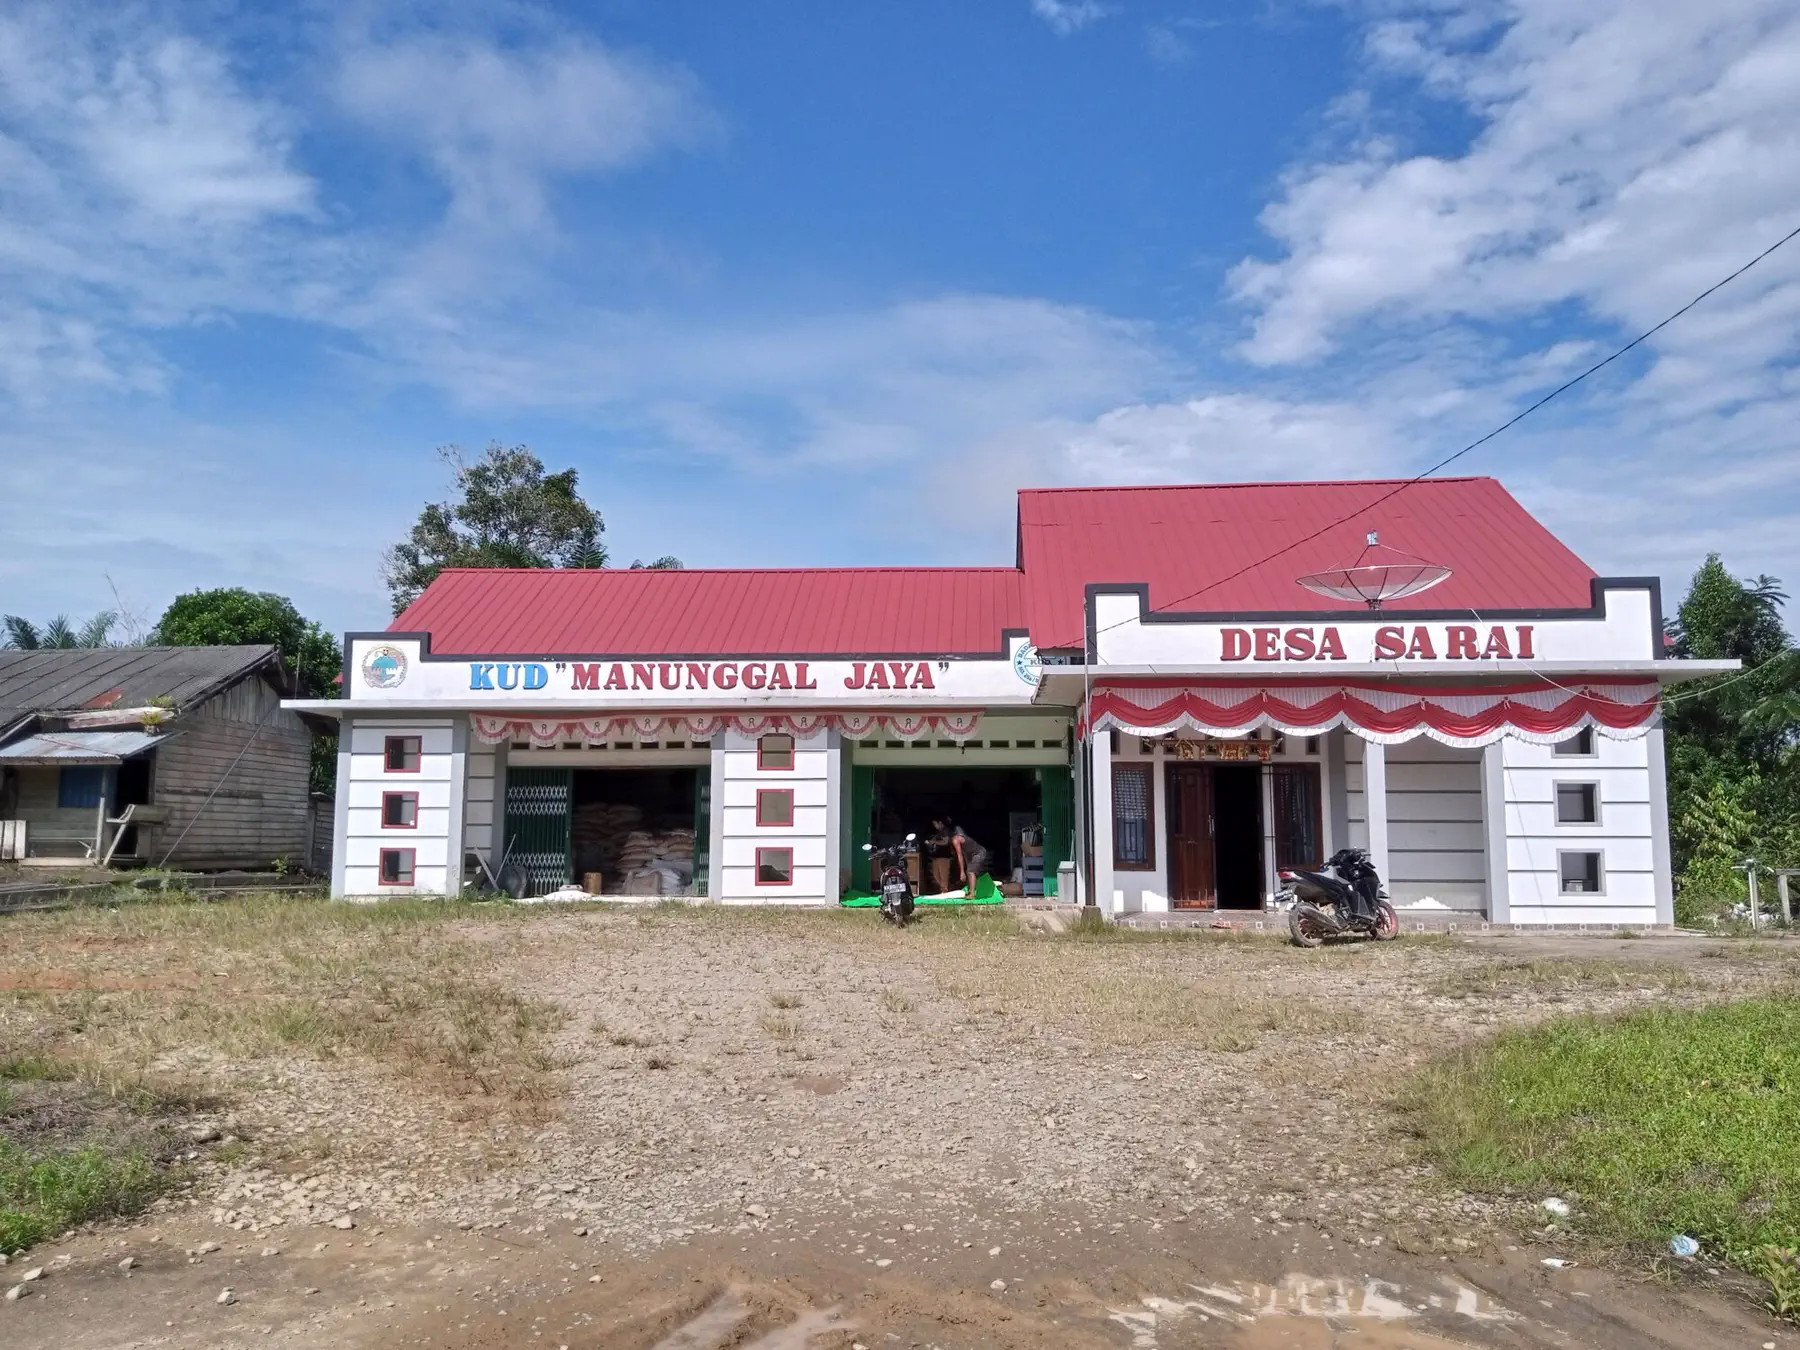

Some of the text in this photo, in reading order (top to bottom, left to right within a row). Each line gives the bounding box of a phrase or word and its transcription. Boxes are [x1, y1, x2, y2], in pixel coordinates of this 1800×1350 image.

[1220, 625, 1535, 661] DESA SARAI
[469, 663, 549, 690] KUD
